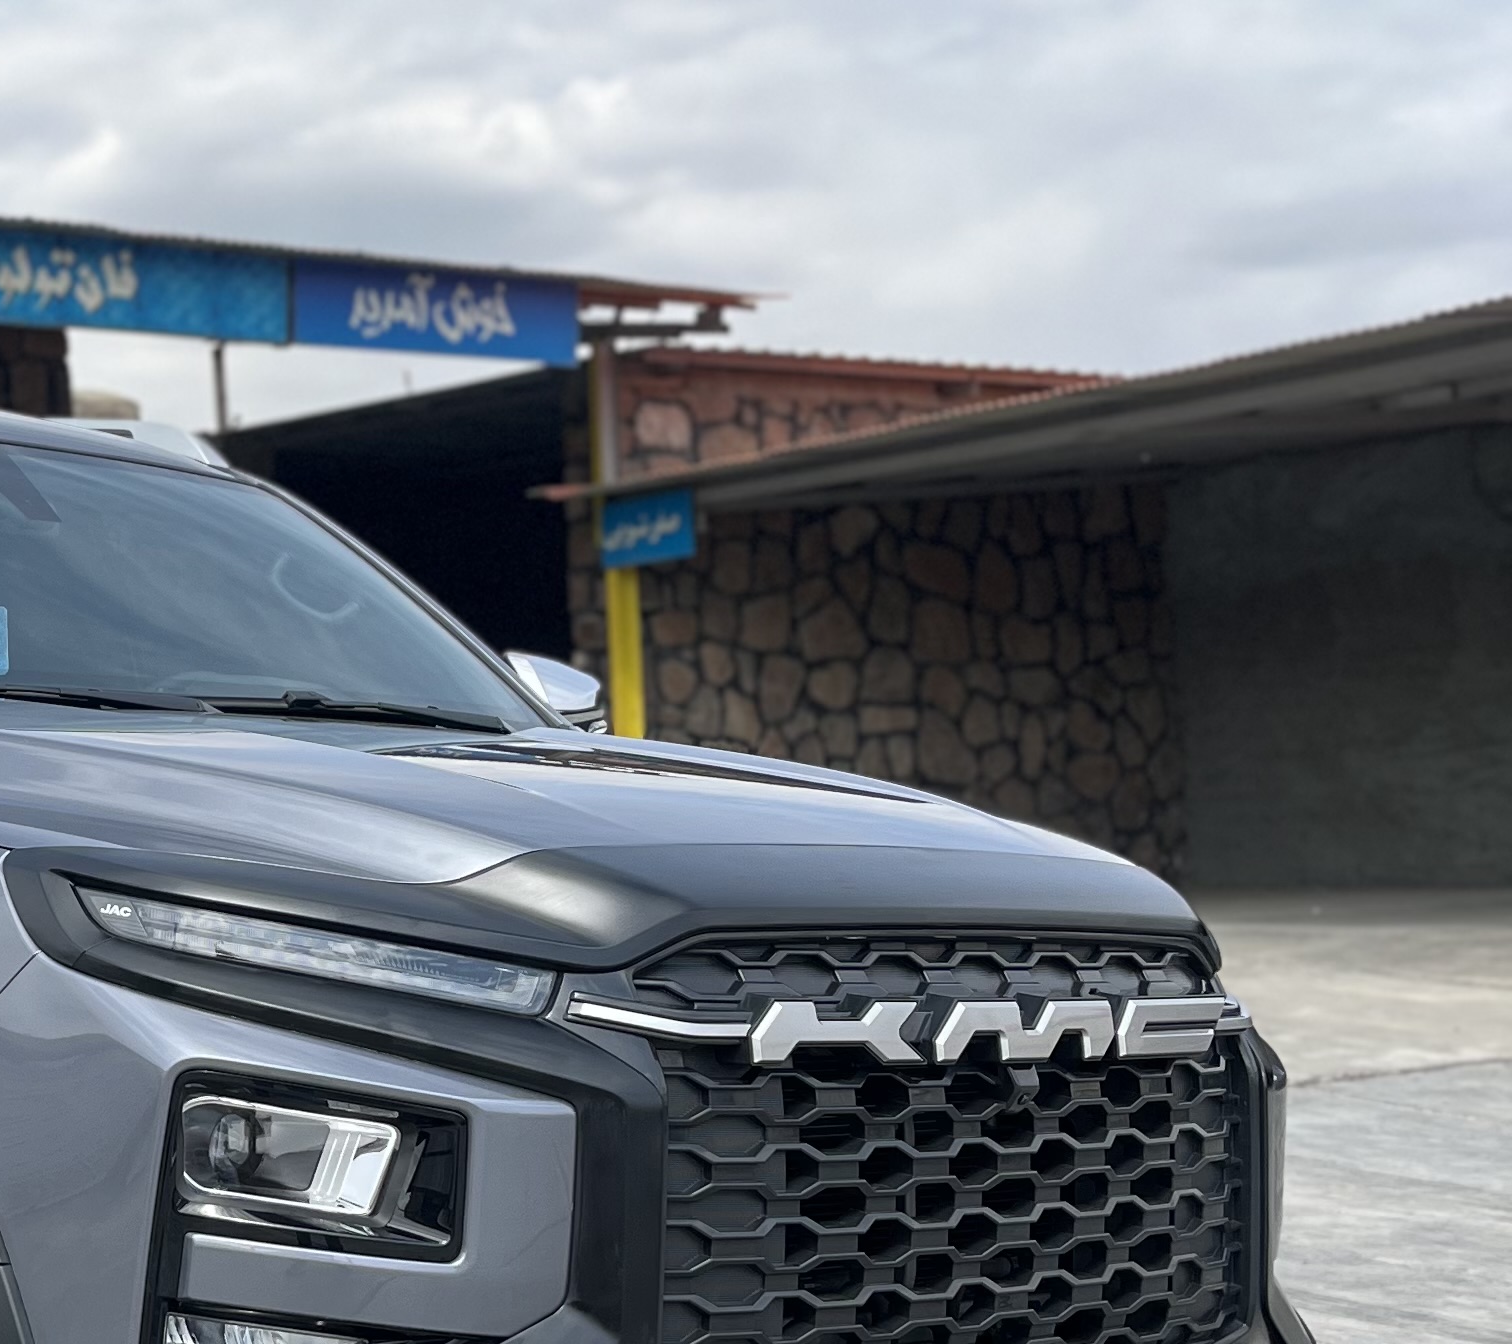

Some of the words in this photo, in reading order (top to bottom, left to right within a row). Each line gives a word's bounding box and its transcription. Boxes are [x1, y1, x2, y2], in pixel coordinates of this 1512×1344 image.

[432, 280, 517, 344] خوش
[100, 903, 132, 917] JAC
[750, 997, 1227, 1066] KMC
